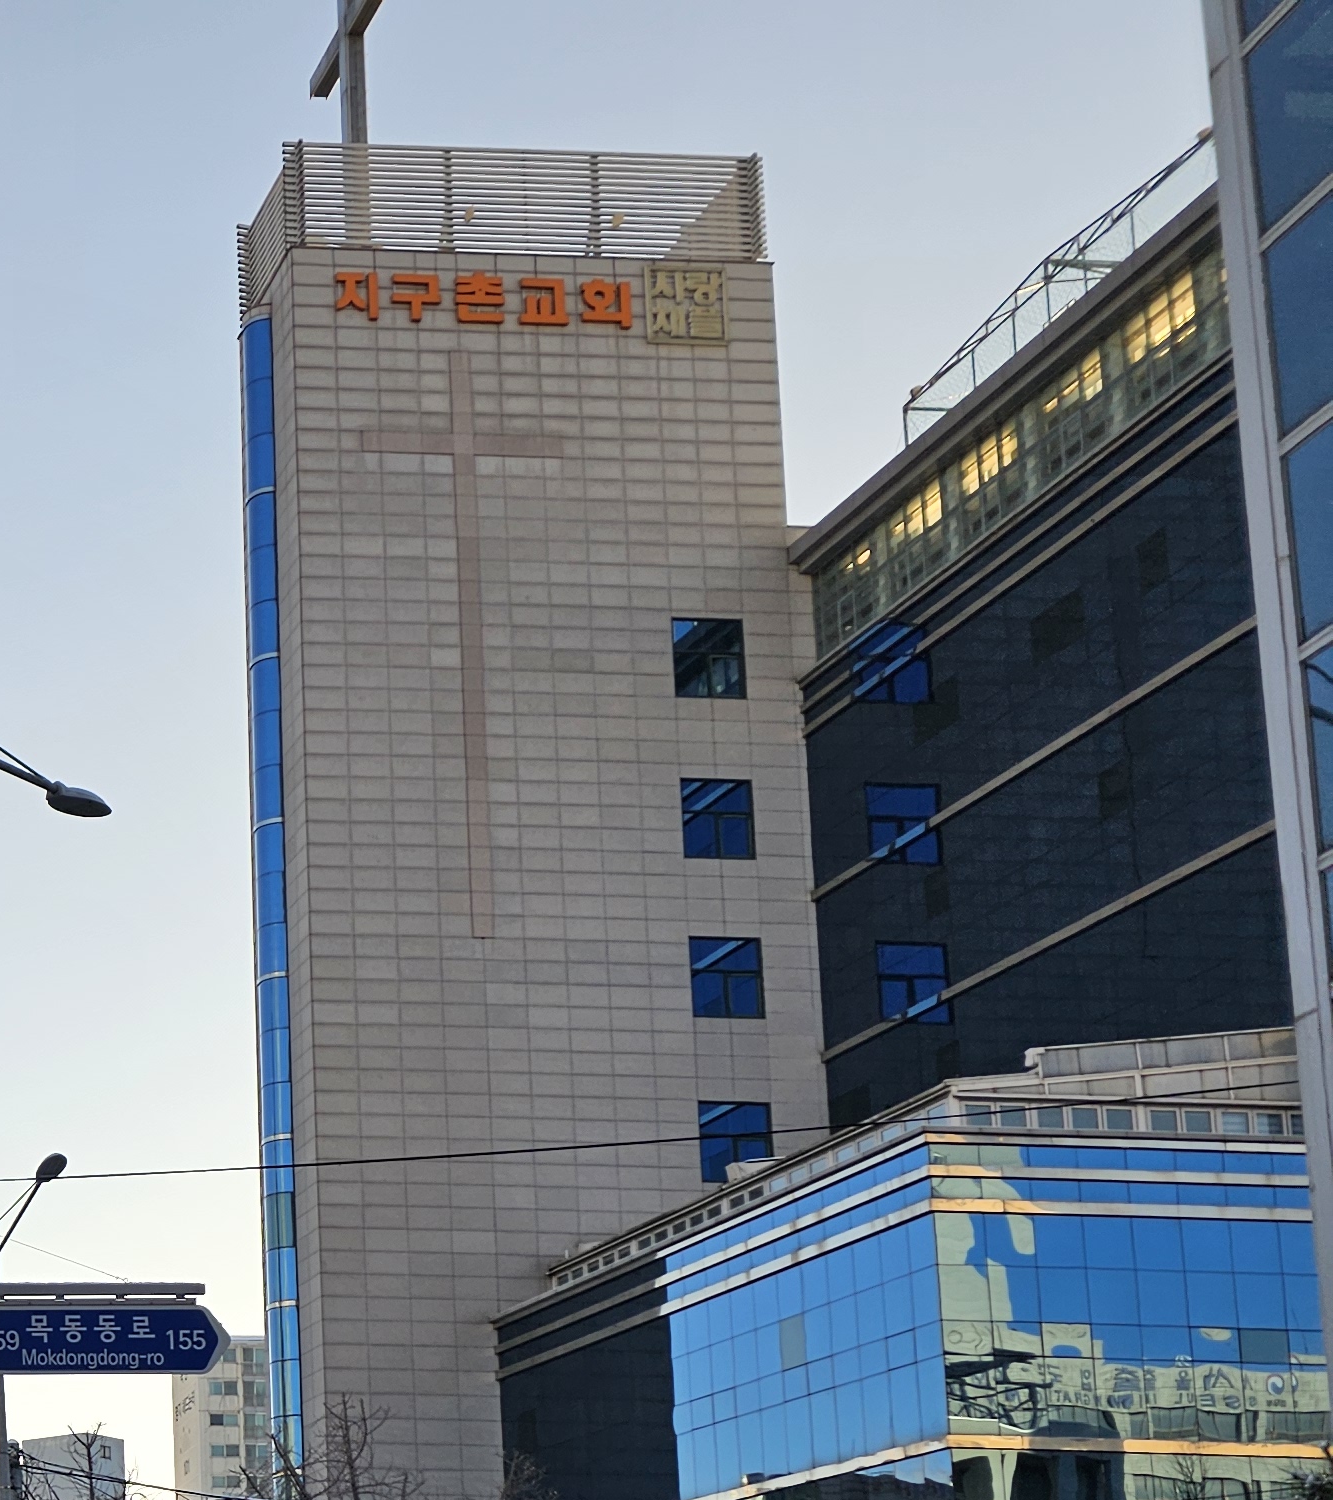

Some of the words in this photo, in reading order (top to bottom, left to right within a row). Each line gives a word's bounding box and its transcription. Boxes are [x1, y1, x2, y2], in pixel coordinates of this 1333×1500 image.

[336, 271, 632, 329] 지구촌교회
[652, 272, 721, 306] 사랑
[26, 1314, 156, 1343] 목동동로
[166, 1330, 207, 1350] 155
[22, 1349, 164, 1369] Mokdongdong-ro
